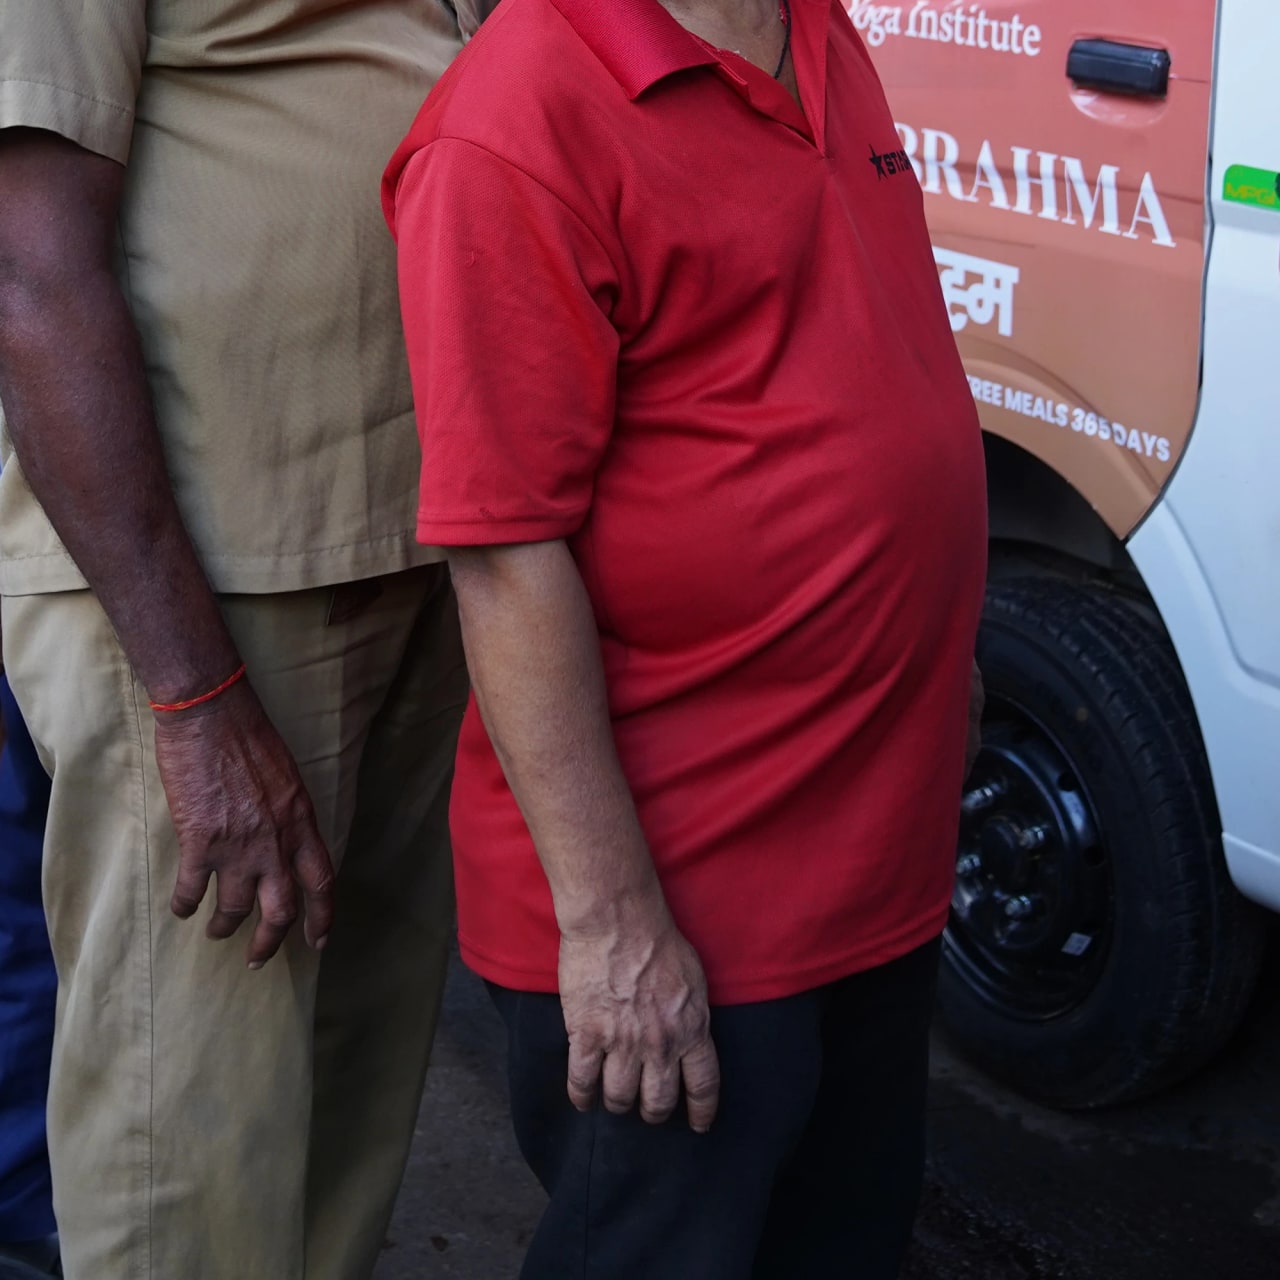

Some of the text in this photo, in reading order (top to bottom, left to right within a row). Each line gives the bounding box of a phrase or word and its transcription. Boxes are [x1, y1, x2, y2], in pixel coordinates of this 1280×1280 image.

[1004, 387, 1069, 427] MEALS
[1070, 407, 1112, 441] 365
[1111, 423, 1170, 462] DAYS
